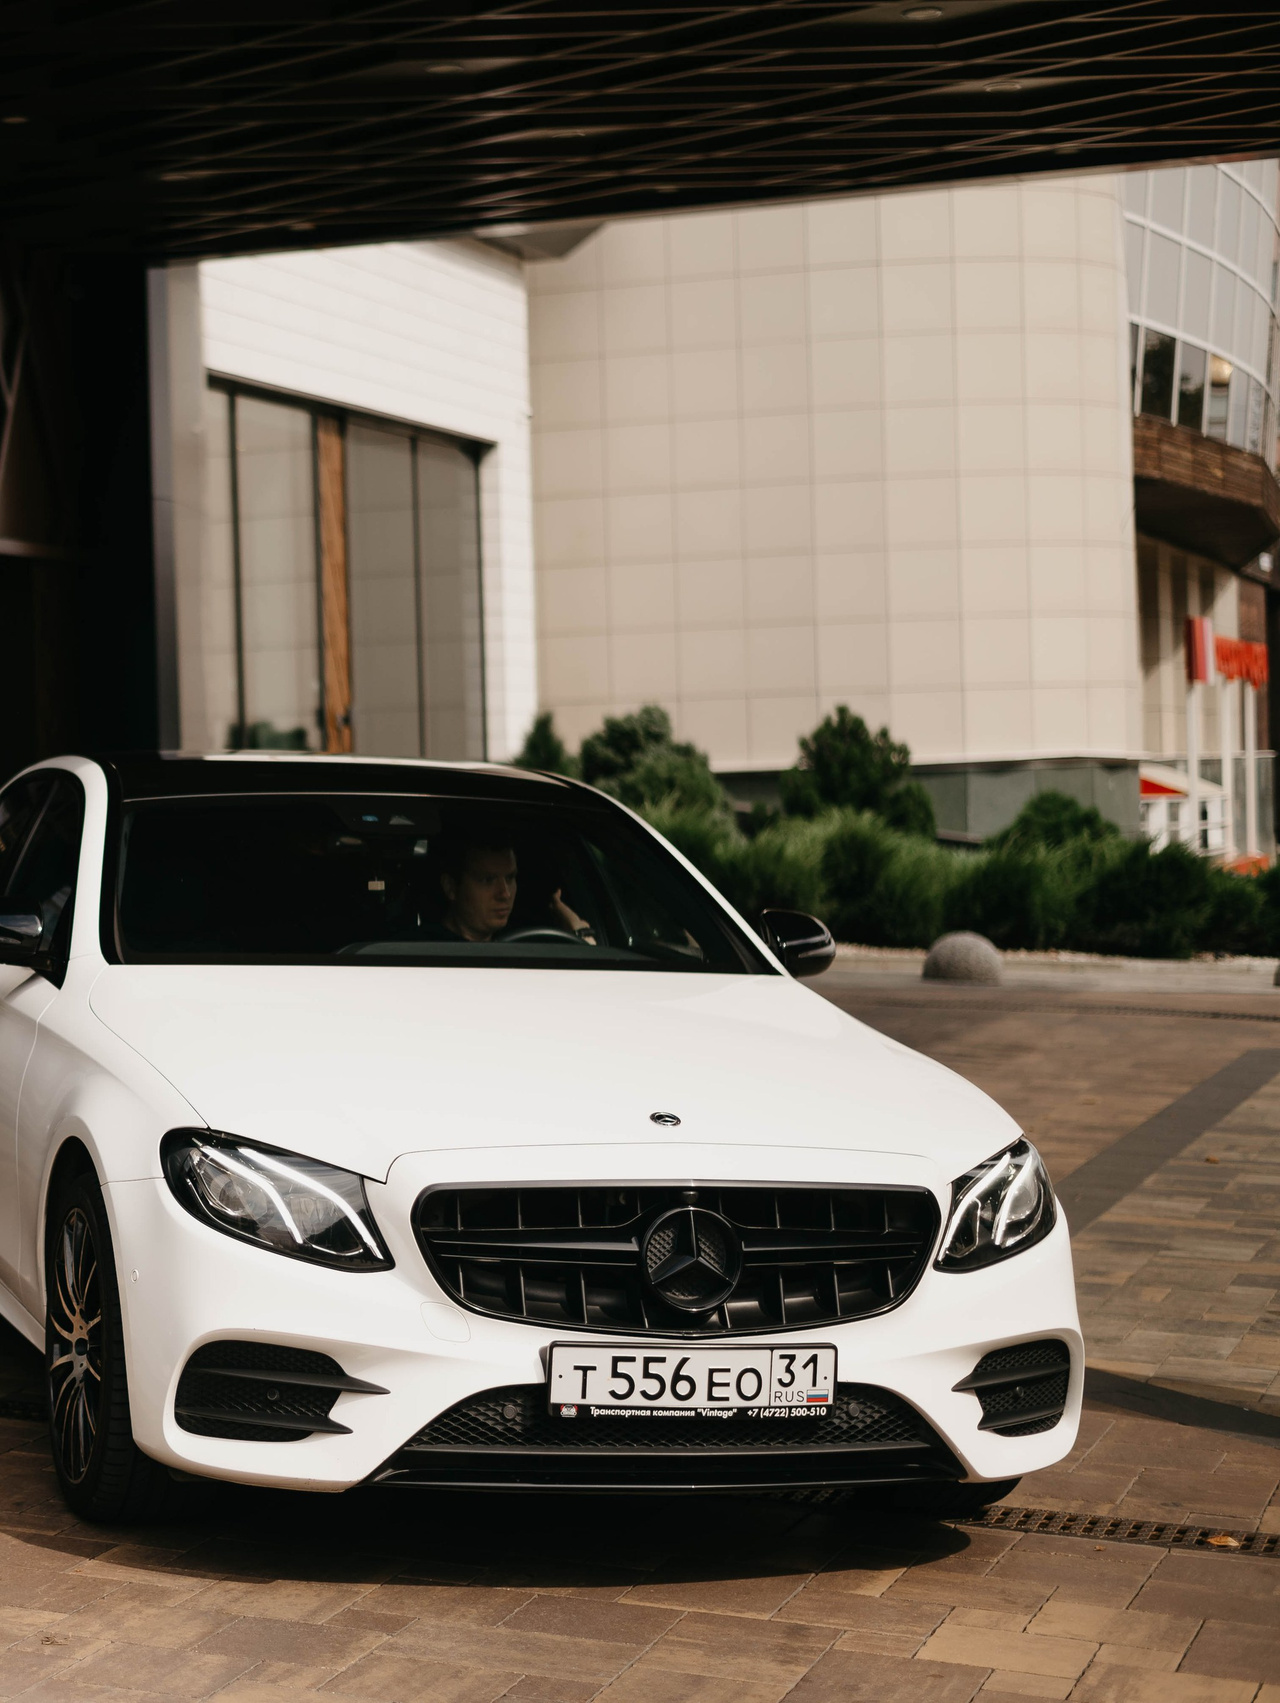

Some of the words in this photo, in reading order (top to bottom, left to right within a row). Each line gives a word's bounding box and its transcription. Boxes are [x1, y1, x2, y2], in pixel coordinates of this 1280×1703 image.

[777, 1354, 818, 1388] 31
[774, 1390, 804, 1403] RUS
[590, 1406, 651, 1418] Транспортная
[652, 1408, 695, 1417] компания
[697, 1408, 737, 1418] "Vintage"
[747, 1408, 759, 1417] +7
[760, 1407, 789, 1418] (4722)
[790, 1407, 827, 1417] 500-510
